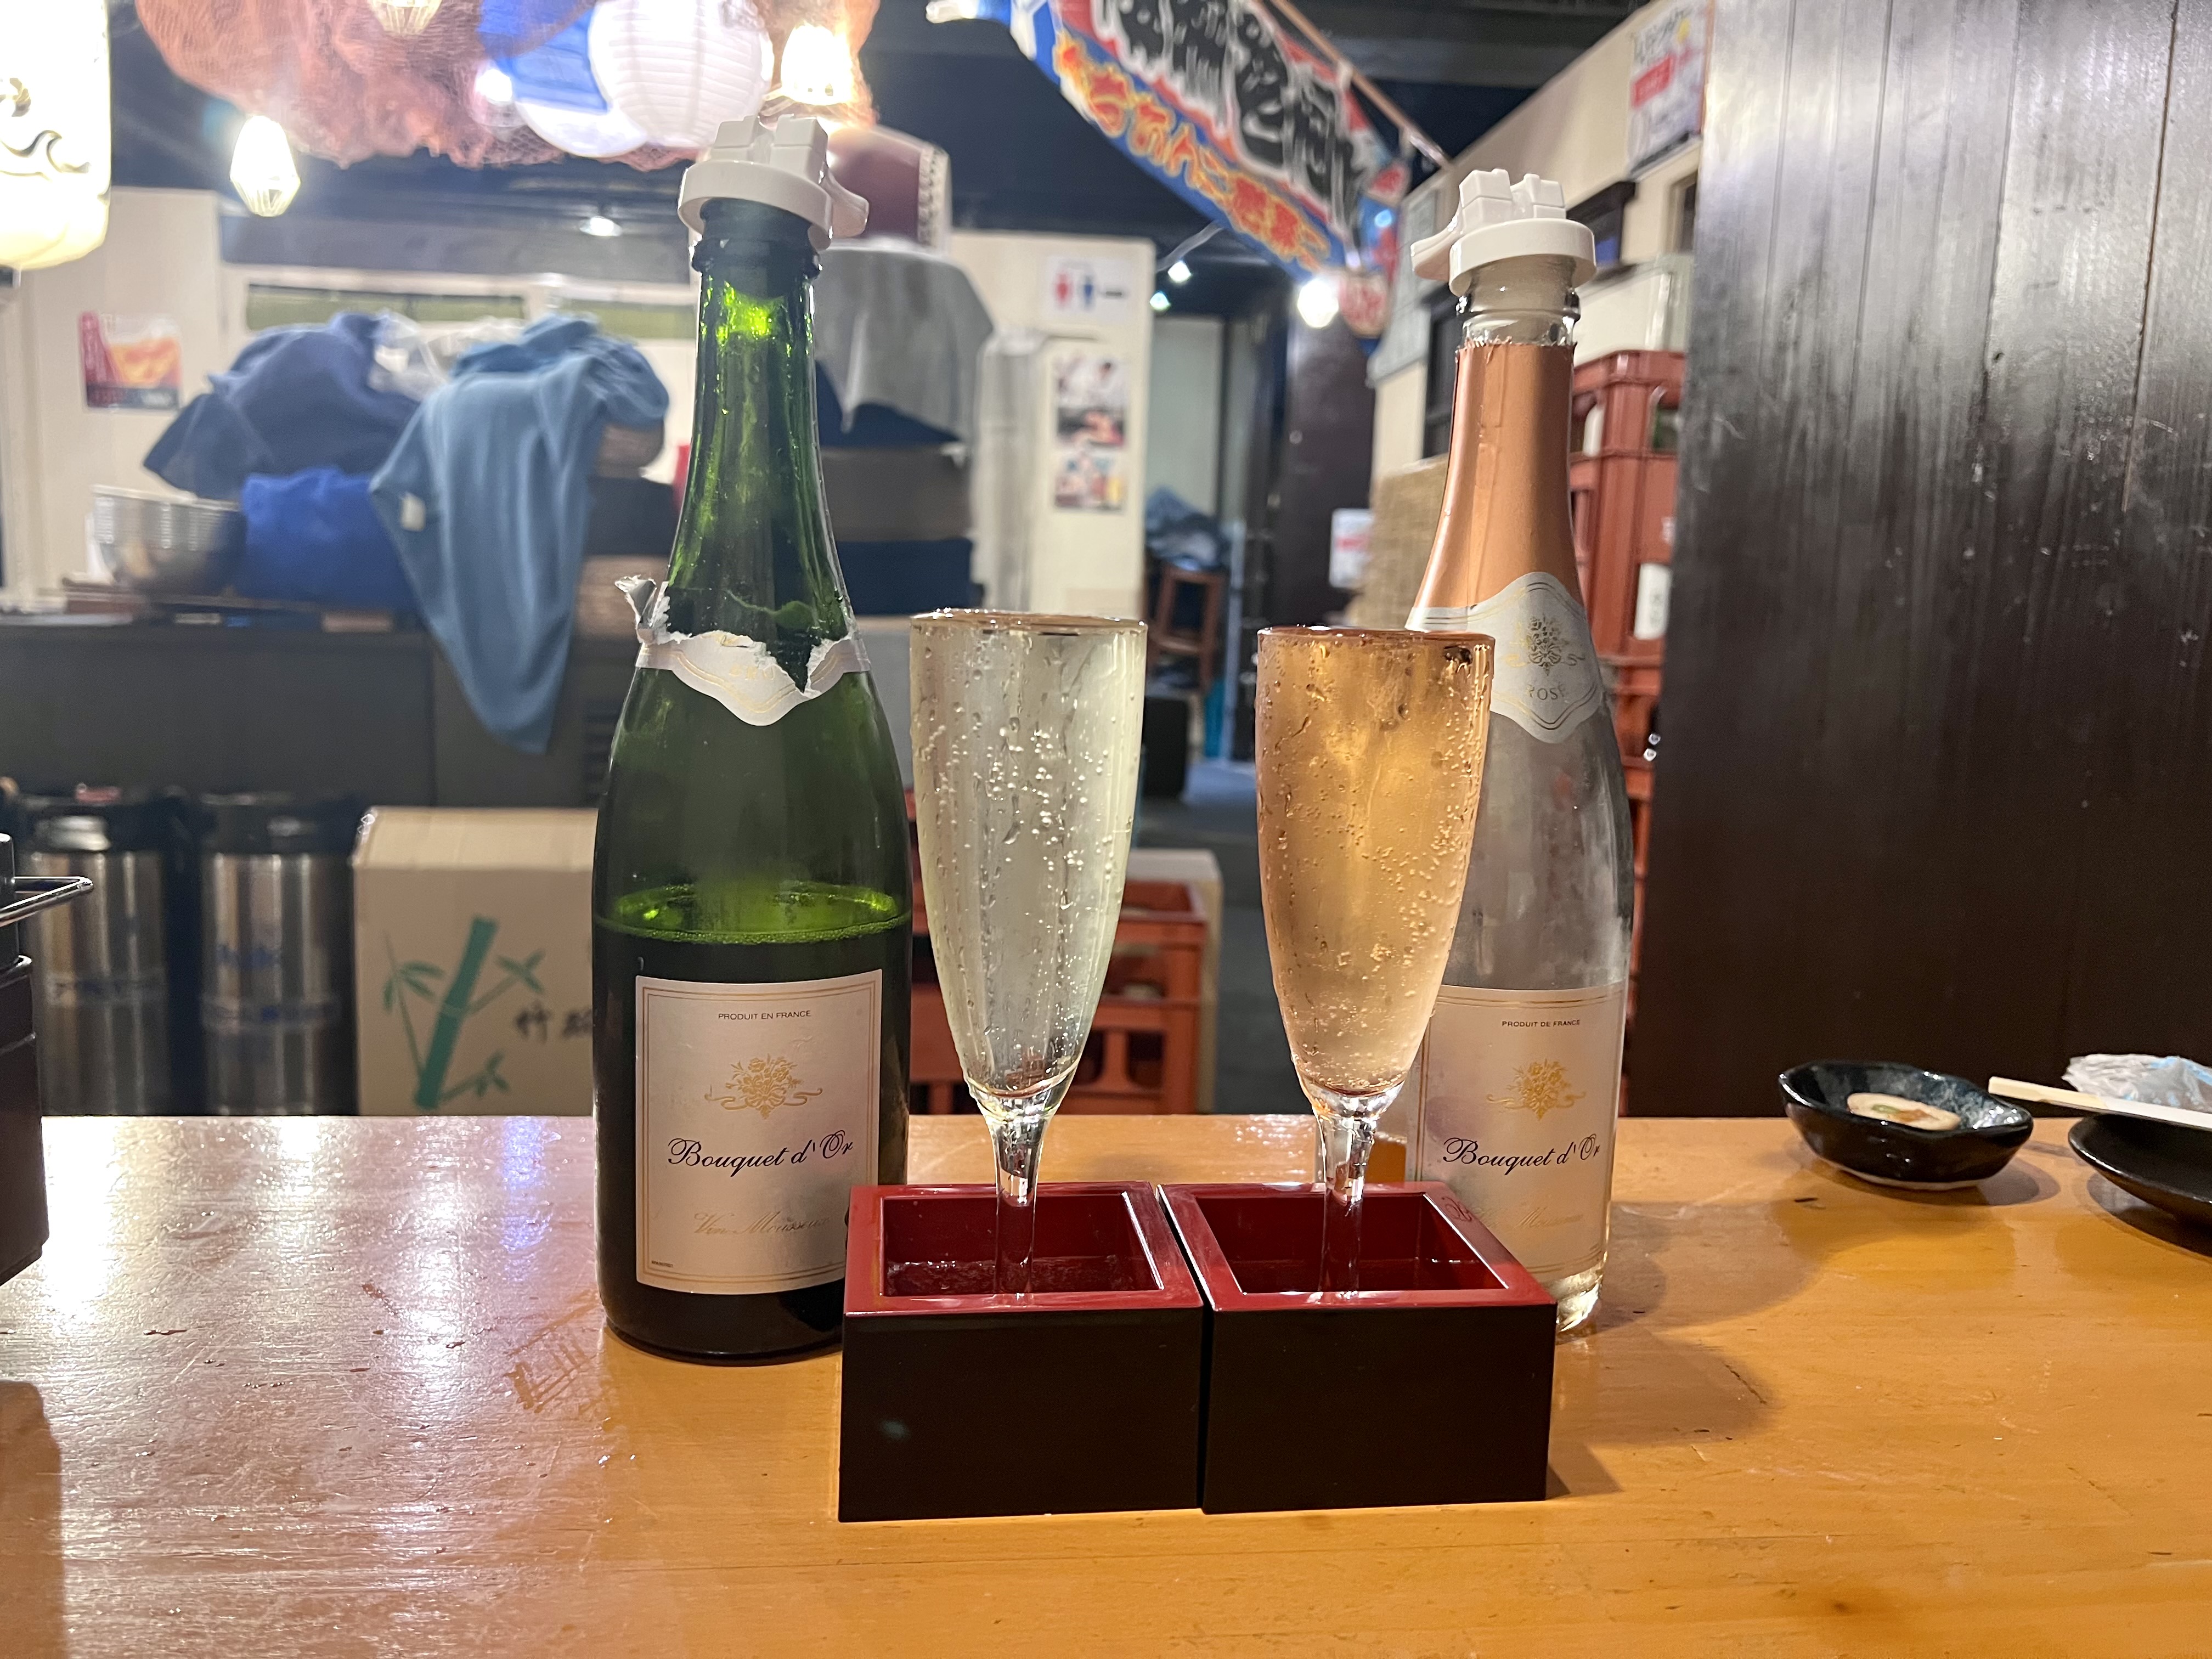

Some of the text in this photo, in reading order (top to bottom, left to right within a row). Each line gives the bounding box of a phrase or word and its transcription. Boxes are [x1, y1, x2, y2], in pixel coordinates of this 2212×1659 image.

[776, 1010, 811, 1019] FRANCE
[668, 1130, 853, 1177] Bouquet d'Or
[1443, 1137, 1556, 1176] Bouquet
